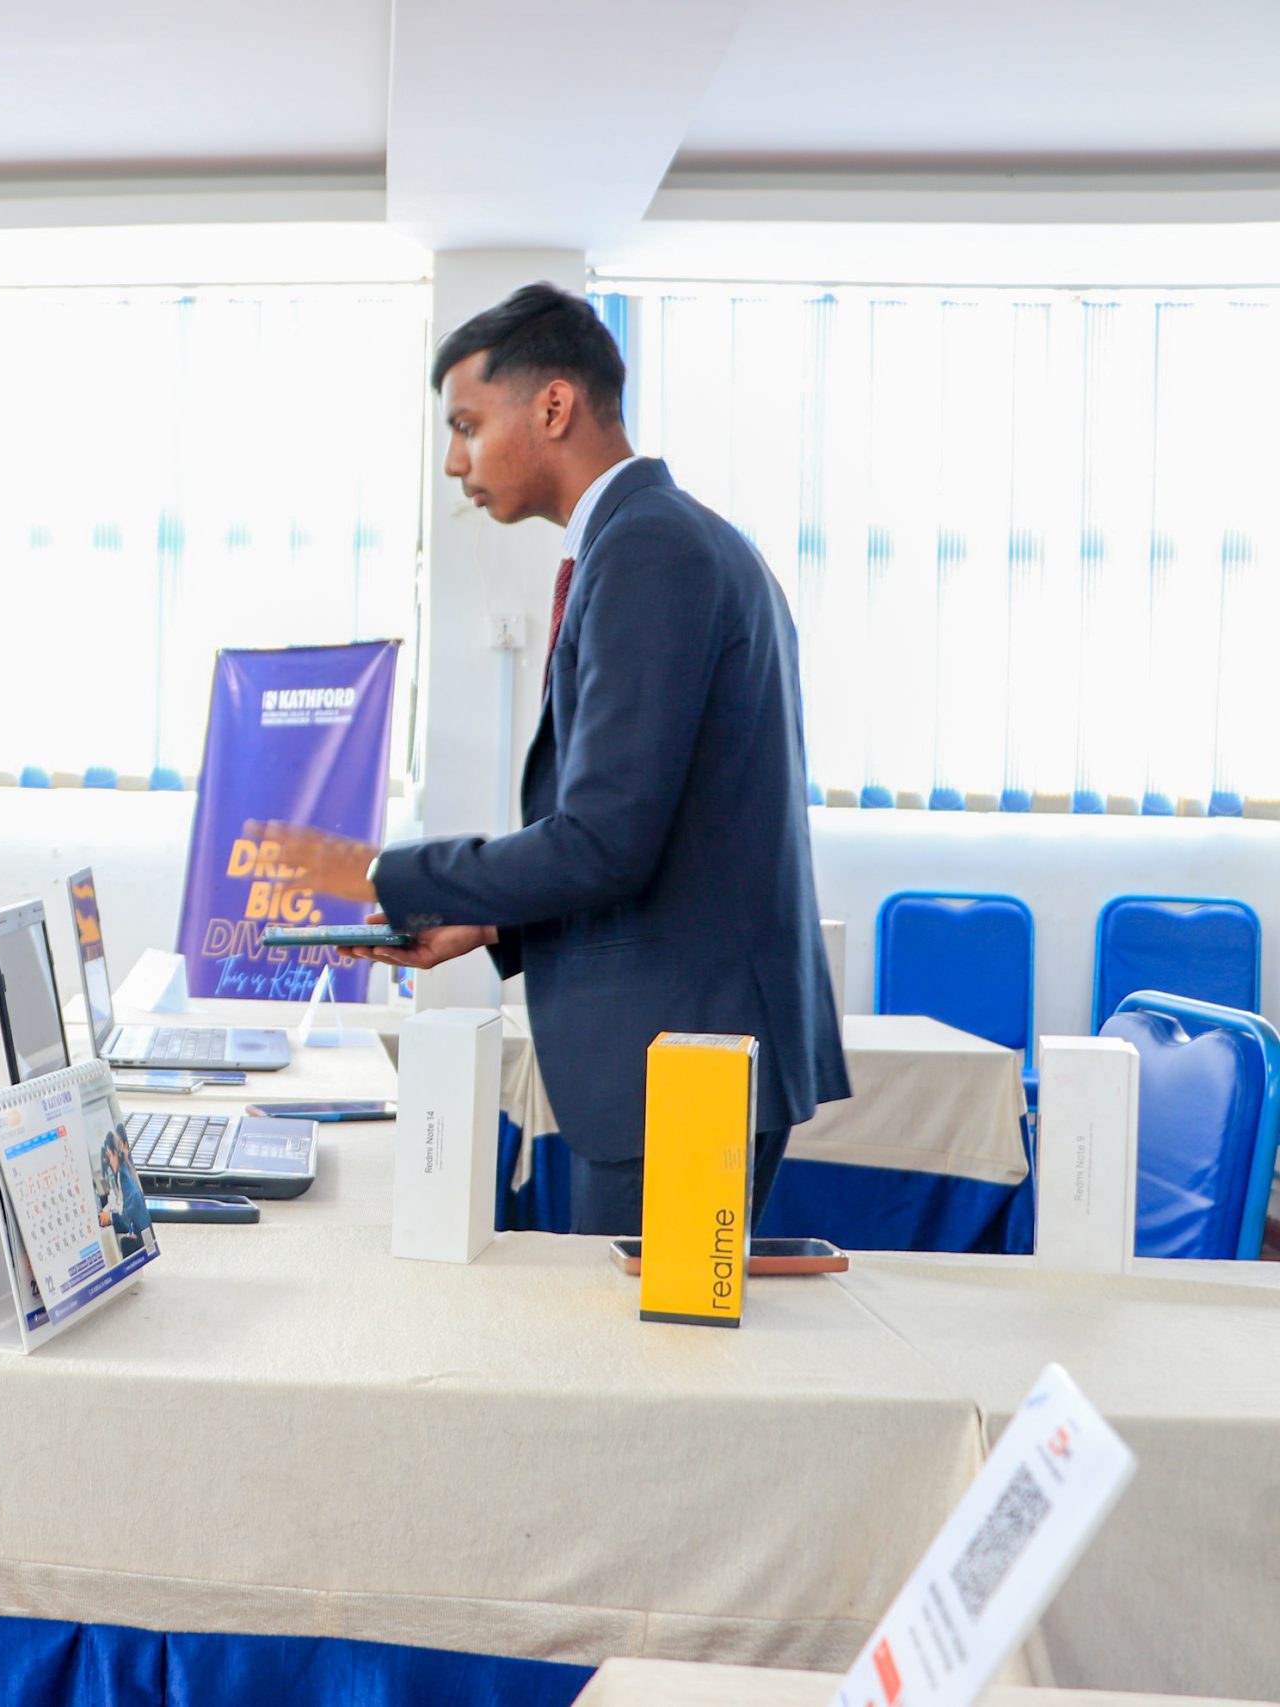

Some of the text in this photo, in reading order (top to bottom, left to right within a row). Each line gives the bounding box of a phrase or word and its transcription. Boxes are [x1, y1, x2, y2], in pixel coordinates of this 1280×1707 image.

[278, 687, 355, 709] KATHFORD
[245, 881, 323, 923] BIG.
[213, 953, 248, 996] This
[424, 1110, 434, 1174] Redmi Note 14
[1073, 1135, 1086, 1201] Redmi Note 9
[709, 1209, 735, 1310] realme
